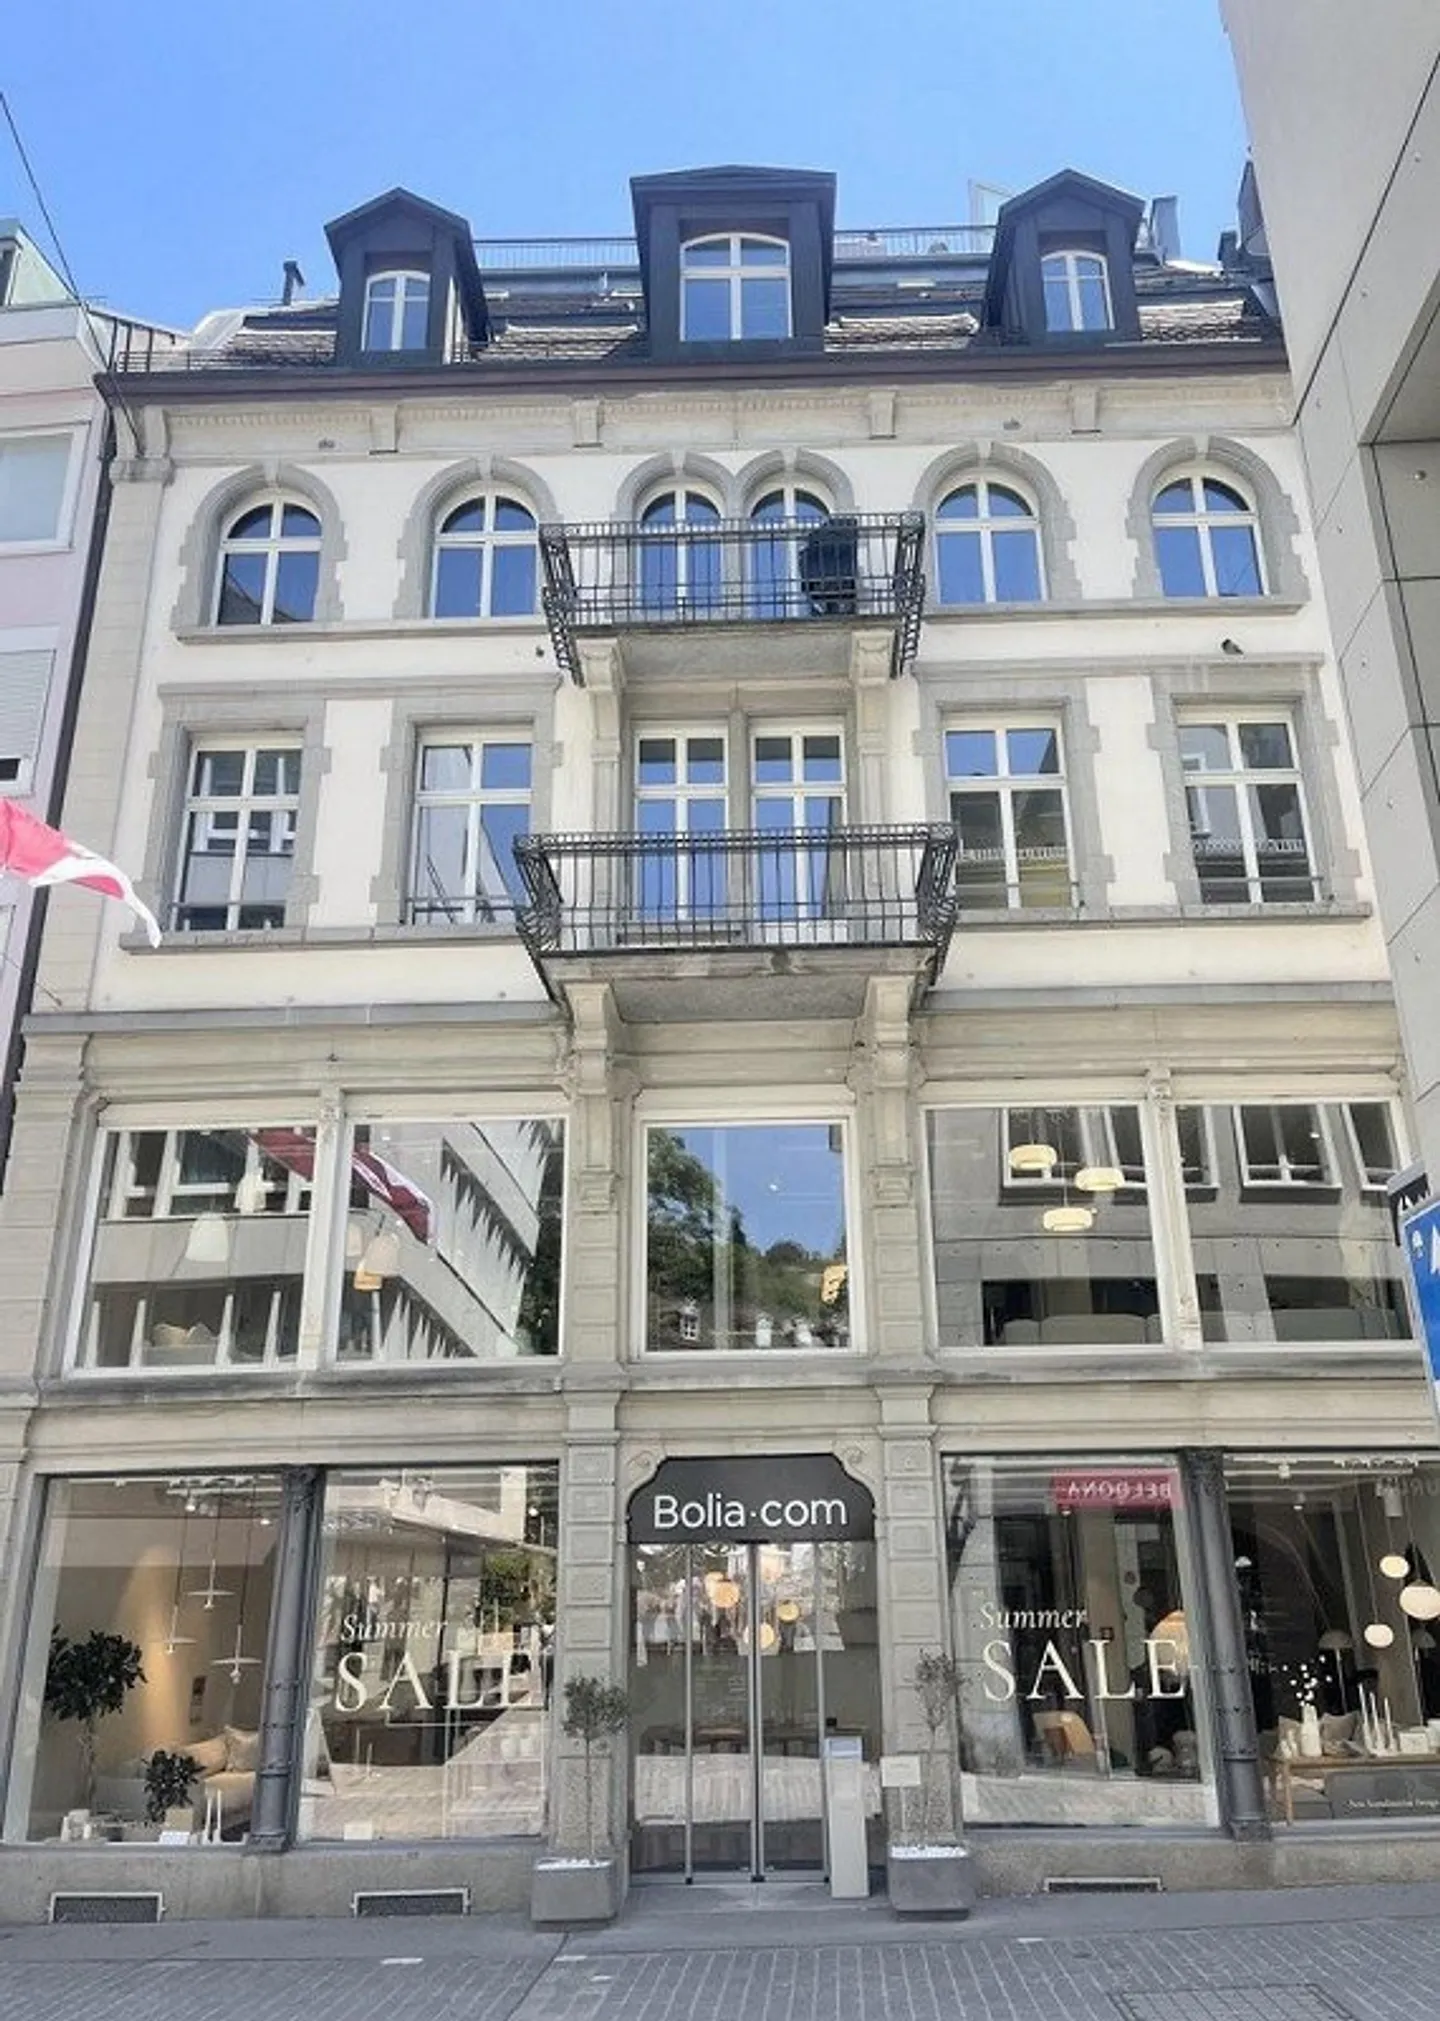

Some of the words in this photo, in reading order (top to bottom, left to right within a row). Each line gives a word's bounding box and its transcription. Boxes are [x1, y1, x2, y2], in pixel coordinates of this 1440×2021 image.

[341, 1614, 448, 1642] Summer
[980, 1602, 1088, 1628] Summer
[334, 1650, 545, 1712] SALE
[982, 1639, 1186, 1701] SALE
